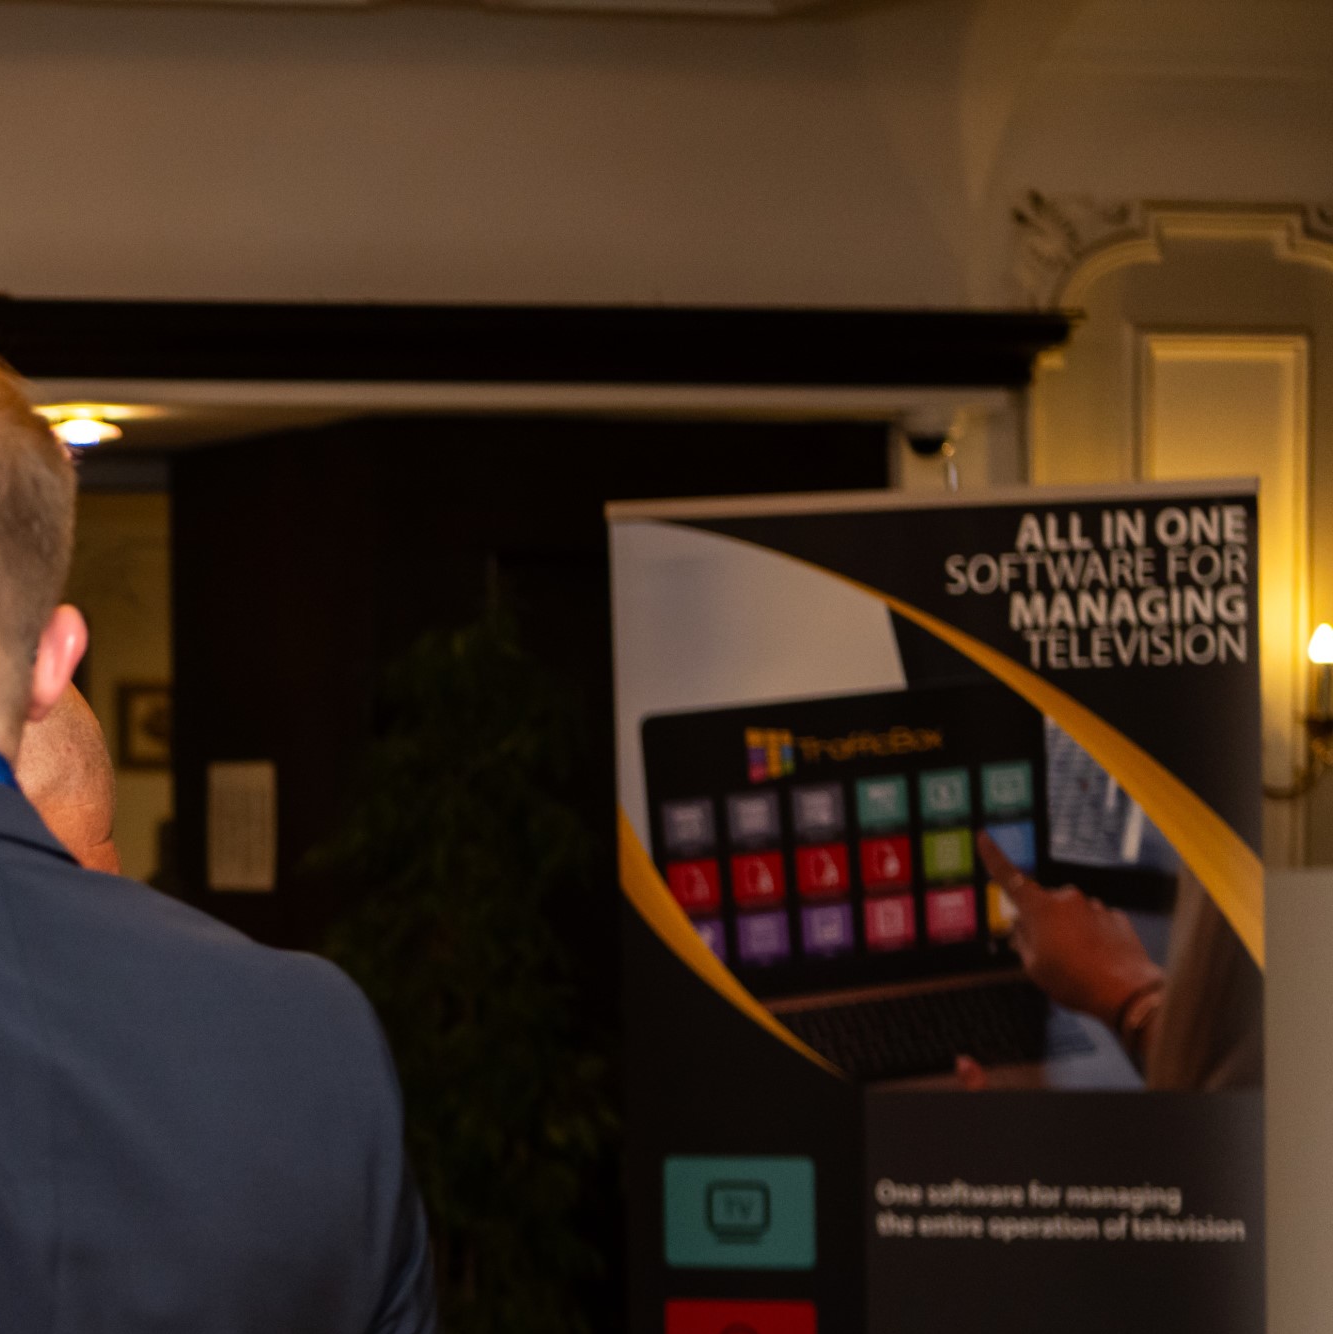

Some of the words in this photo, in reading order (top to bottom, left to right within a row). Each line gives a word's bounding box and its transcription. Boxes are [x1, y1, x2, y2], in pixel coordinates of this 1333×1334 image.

[1014, 512, 1093, 551] ALL
[1101, 508, 1146, 549] IN
[1154, 505, 1248, 547] ONE
[944, 548, 1157, 595] SOFTWARE
[1166, 544, 1248, 586] FOR
[1008, 585, 1248, 631] MANAGING
[1024, 624, 1248, 669] TELEVISION
[874, 1178, 923, 1207] One
[926, 1178, 1025, 1208] software
[1027, 1179, 1061, 1208] for
[1064, 1183, 1182, 1215] managing
[875, 1209, 914, 1237] the
[917, 1211, 984, 1238] entire
[987, 1211, 1099, 1243] operation
[1102, 1212, 1129, 1241] of
[1131, 1214, 1246, 1242] television
